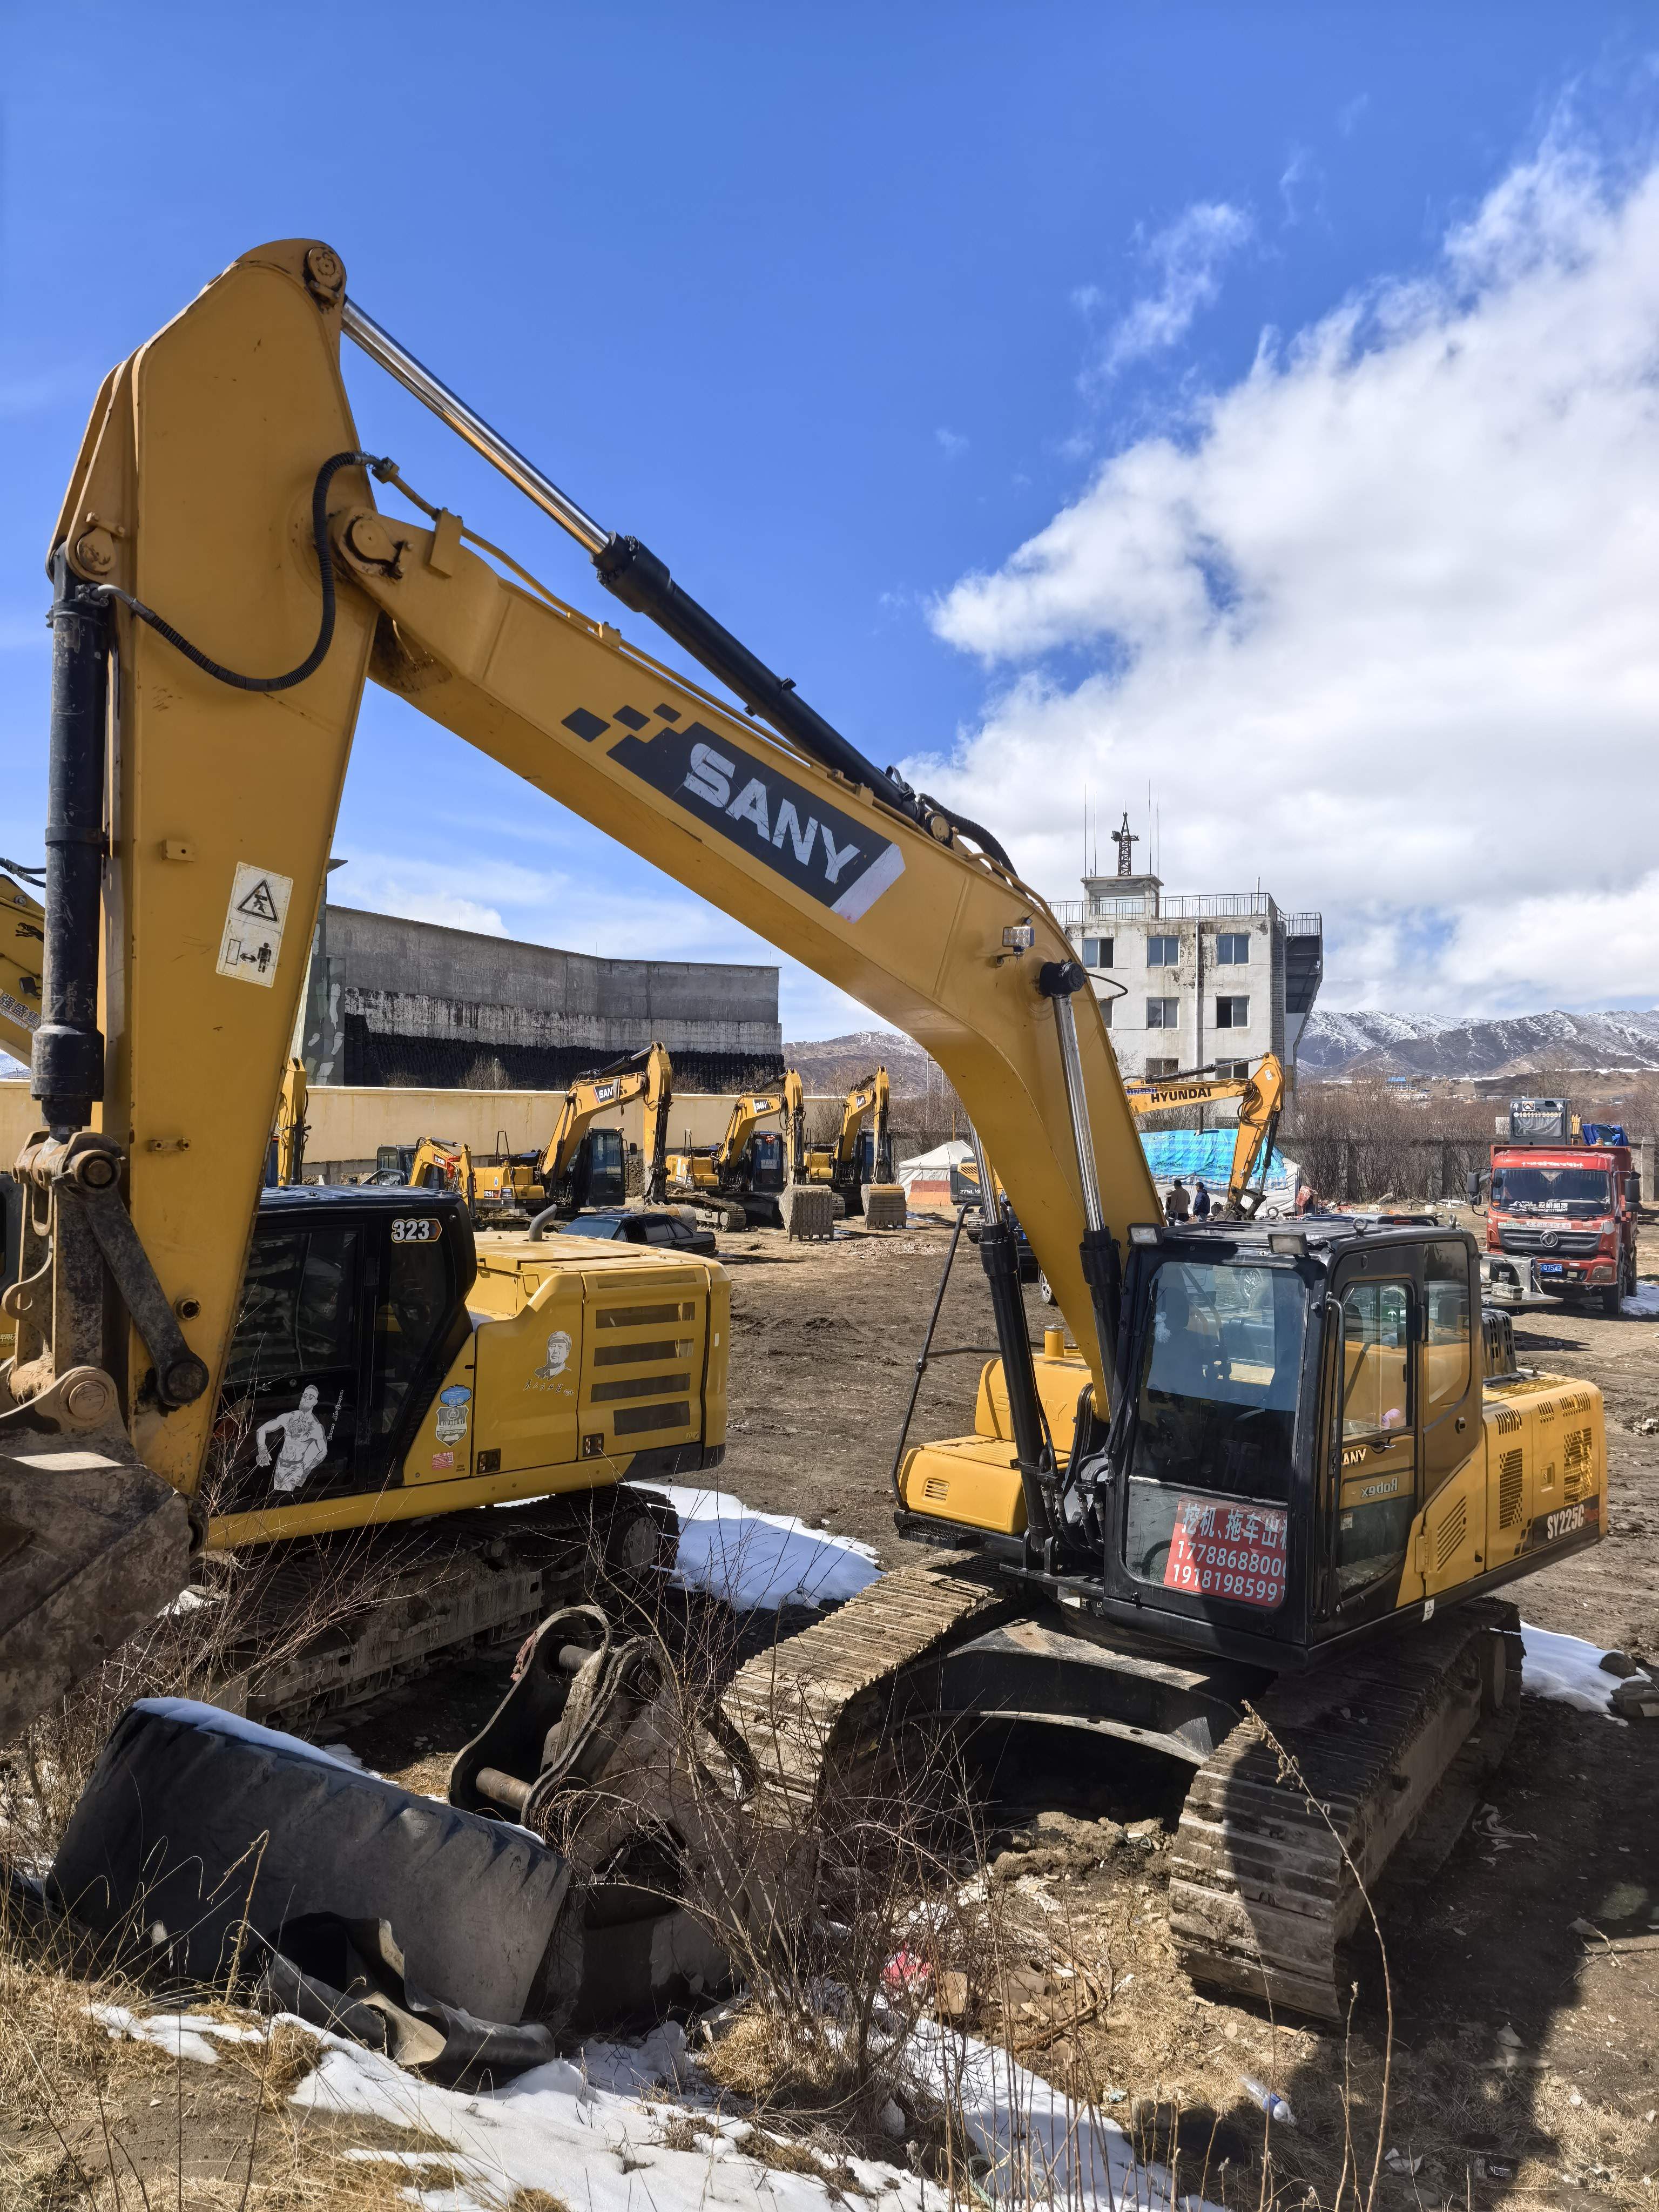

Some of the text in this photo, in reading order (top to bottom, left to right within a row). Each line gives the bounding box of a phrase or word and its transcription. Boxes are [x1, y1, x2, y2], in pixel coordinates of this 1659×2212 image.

[684, 743, 860, 885] SANY
[598, 1086, 614, 1099] SAN
[1151, 1088, 1211, 1103] HYUNDAI
[392, 1219, 430, 1242] 323
[994, 1391, 1068, 1421] SY
[1341, 1448, 1366, 1465] ANY
[1547, 1504, 1584, 1540] SY225C
